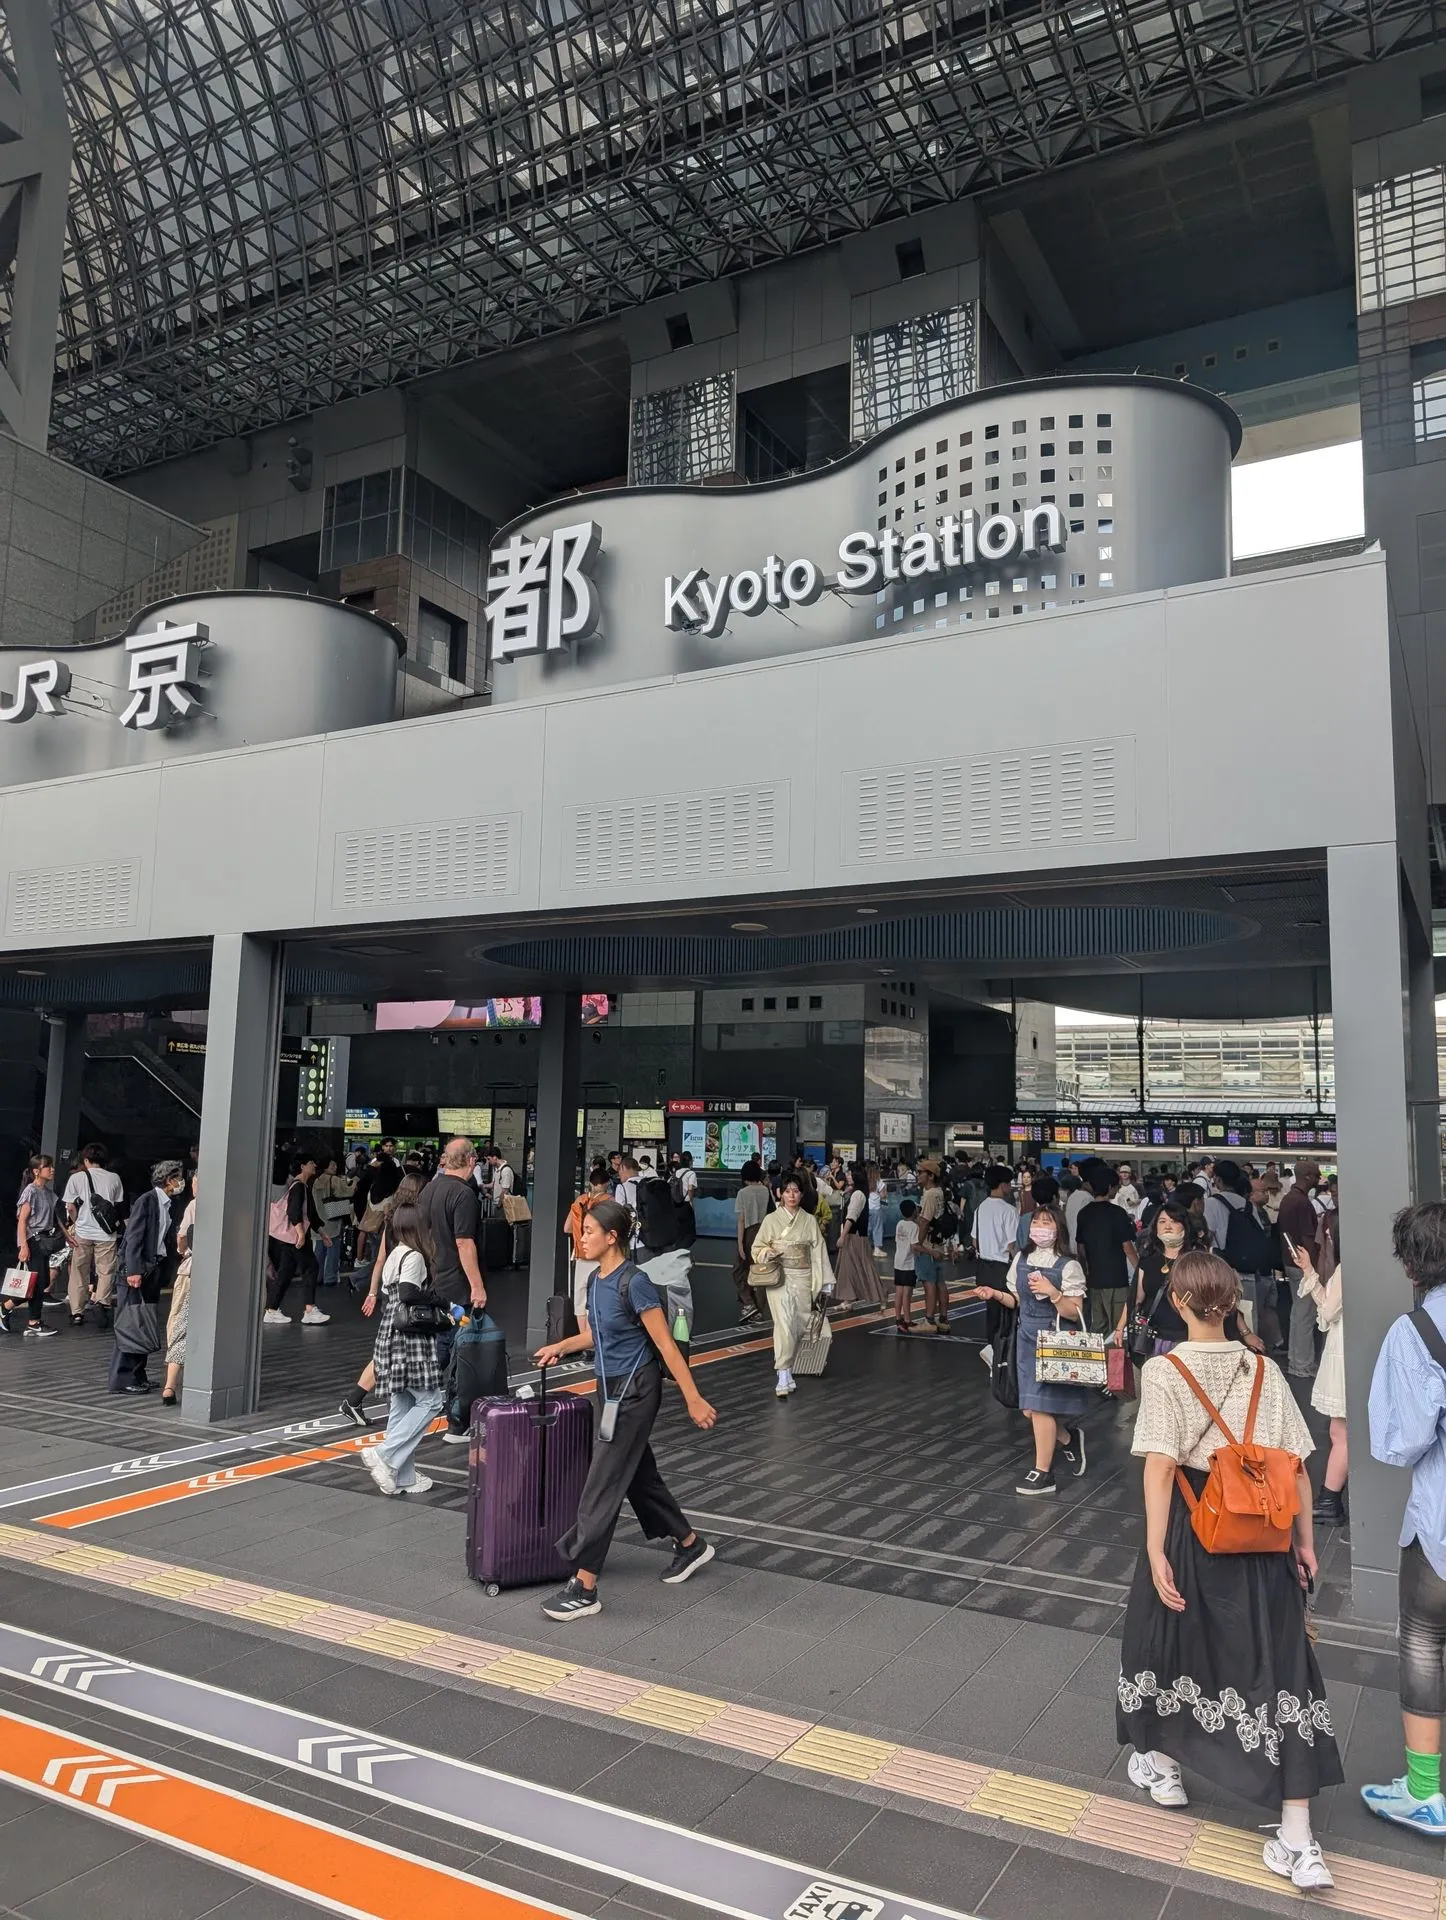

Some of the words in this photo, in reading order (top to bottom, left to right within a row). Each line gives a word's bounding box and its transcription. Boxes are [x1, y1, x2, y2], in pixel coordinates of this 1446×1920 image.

[664, 553, 820, 638] Kyoto
[837, 501, 1065, 590] Station
[0, 660, 66, 722] JR
[120, 620, 205, 729] 京
[484, 521, 600, 662] 都
[1052, 1350, 1080, 1358] CHRISTIAN
[1081, 1351, 1093, 1359] DIOR
[789, 1885, 832, 1919] TAXI
